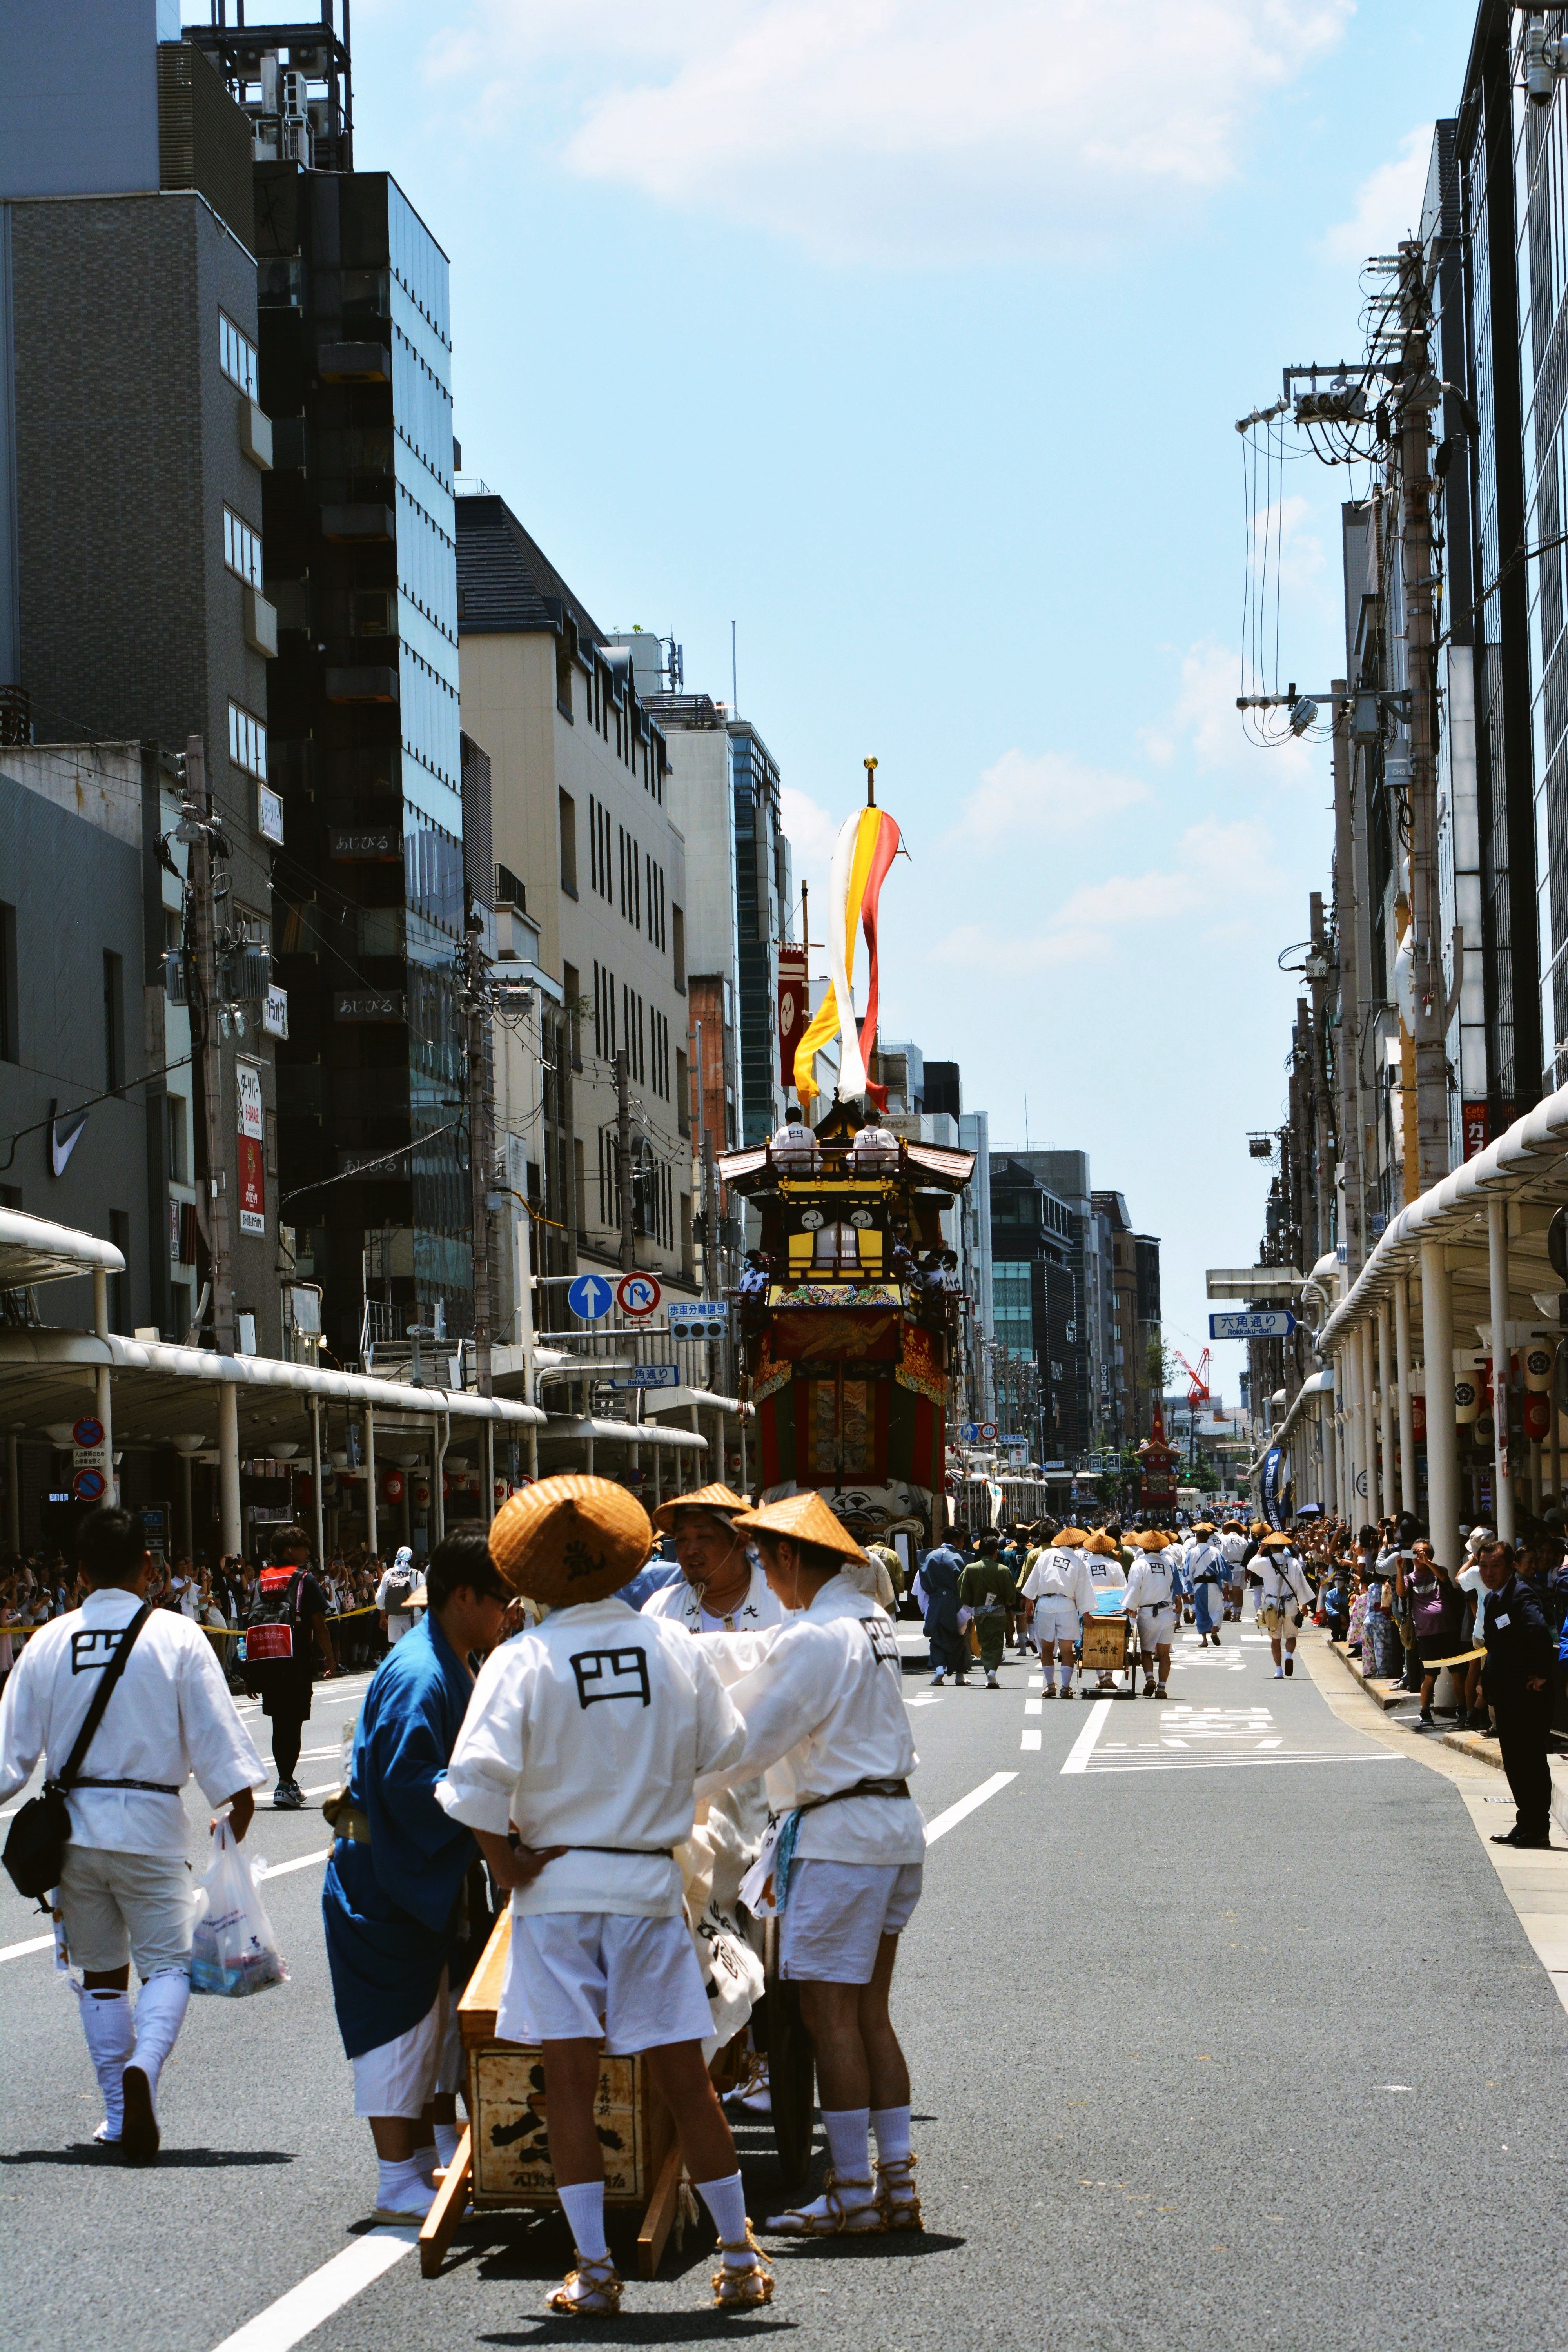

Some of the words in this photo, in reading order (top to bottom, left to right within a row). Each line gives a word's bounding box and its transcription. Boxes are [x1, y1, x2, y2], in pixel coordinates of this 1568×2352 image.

[267, 998, 285, 1022] カラオケ
[339, 999, 392, 1013] あじびる
[241, 1074, 258, 1101] ダーツバー
[343, 1159, 396, 1172] あじびる
[670, 1303, 726, 1316] 歩車分離信号
[1221, 1315, 1276, 1329] 六角通り
[1228, 1327, 1272, 1335] Rokkaku-dori
[635, 1368, 668, 1379] 角通り
[984, 1427, 994, 1436] 40
[1265, 1465, 1281, 1531] 河原町商店街
[263, 1583, 287, 1592] 救急救命
[743, 1605, 759, 1618] 大
[252, 1631, 284, 1642] 救急救命士
[1088, 1646, 1118, 1655] 一保堂
